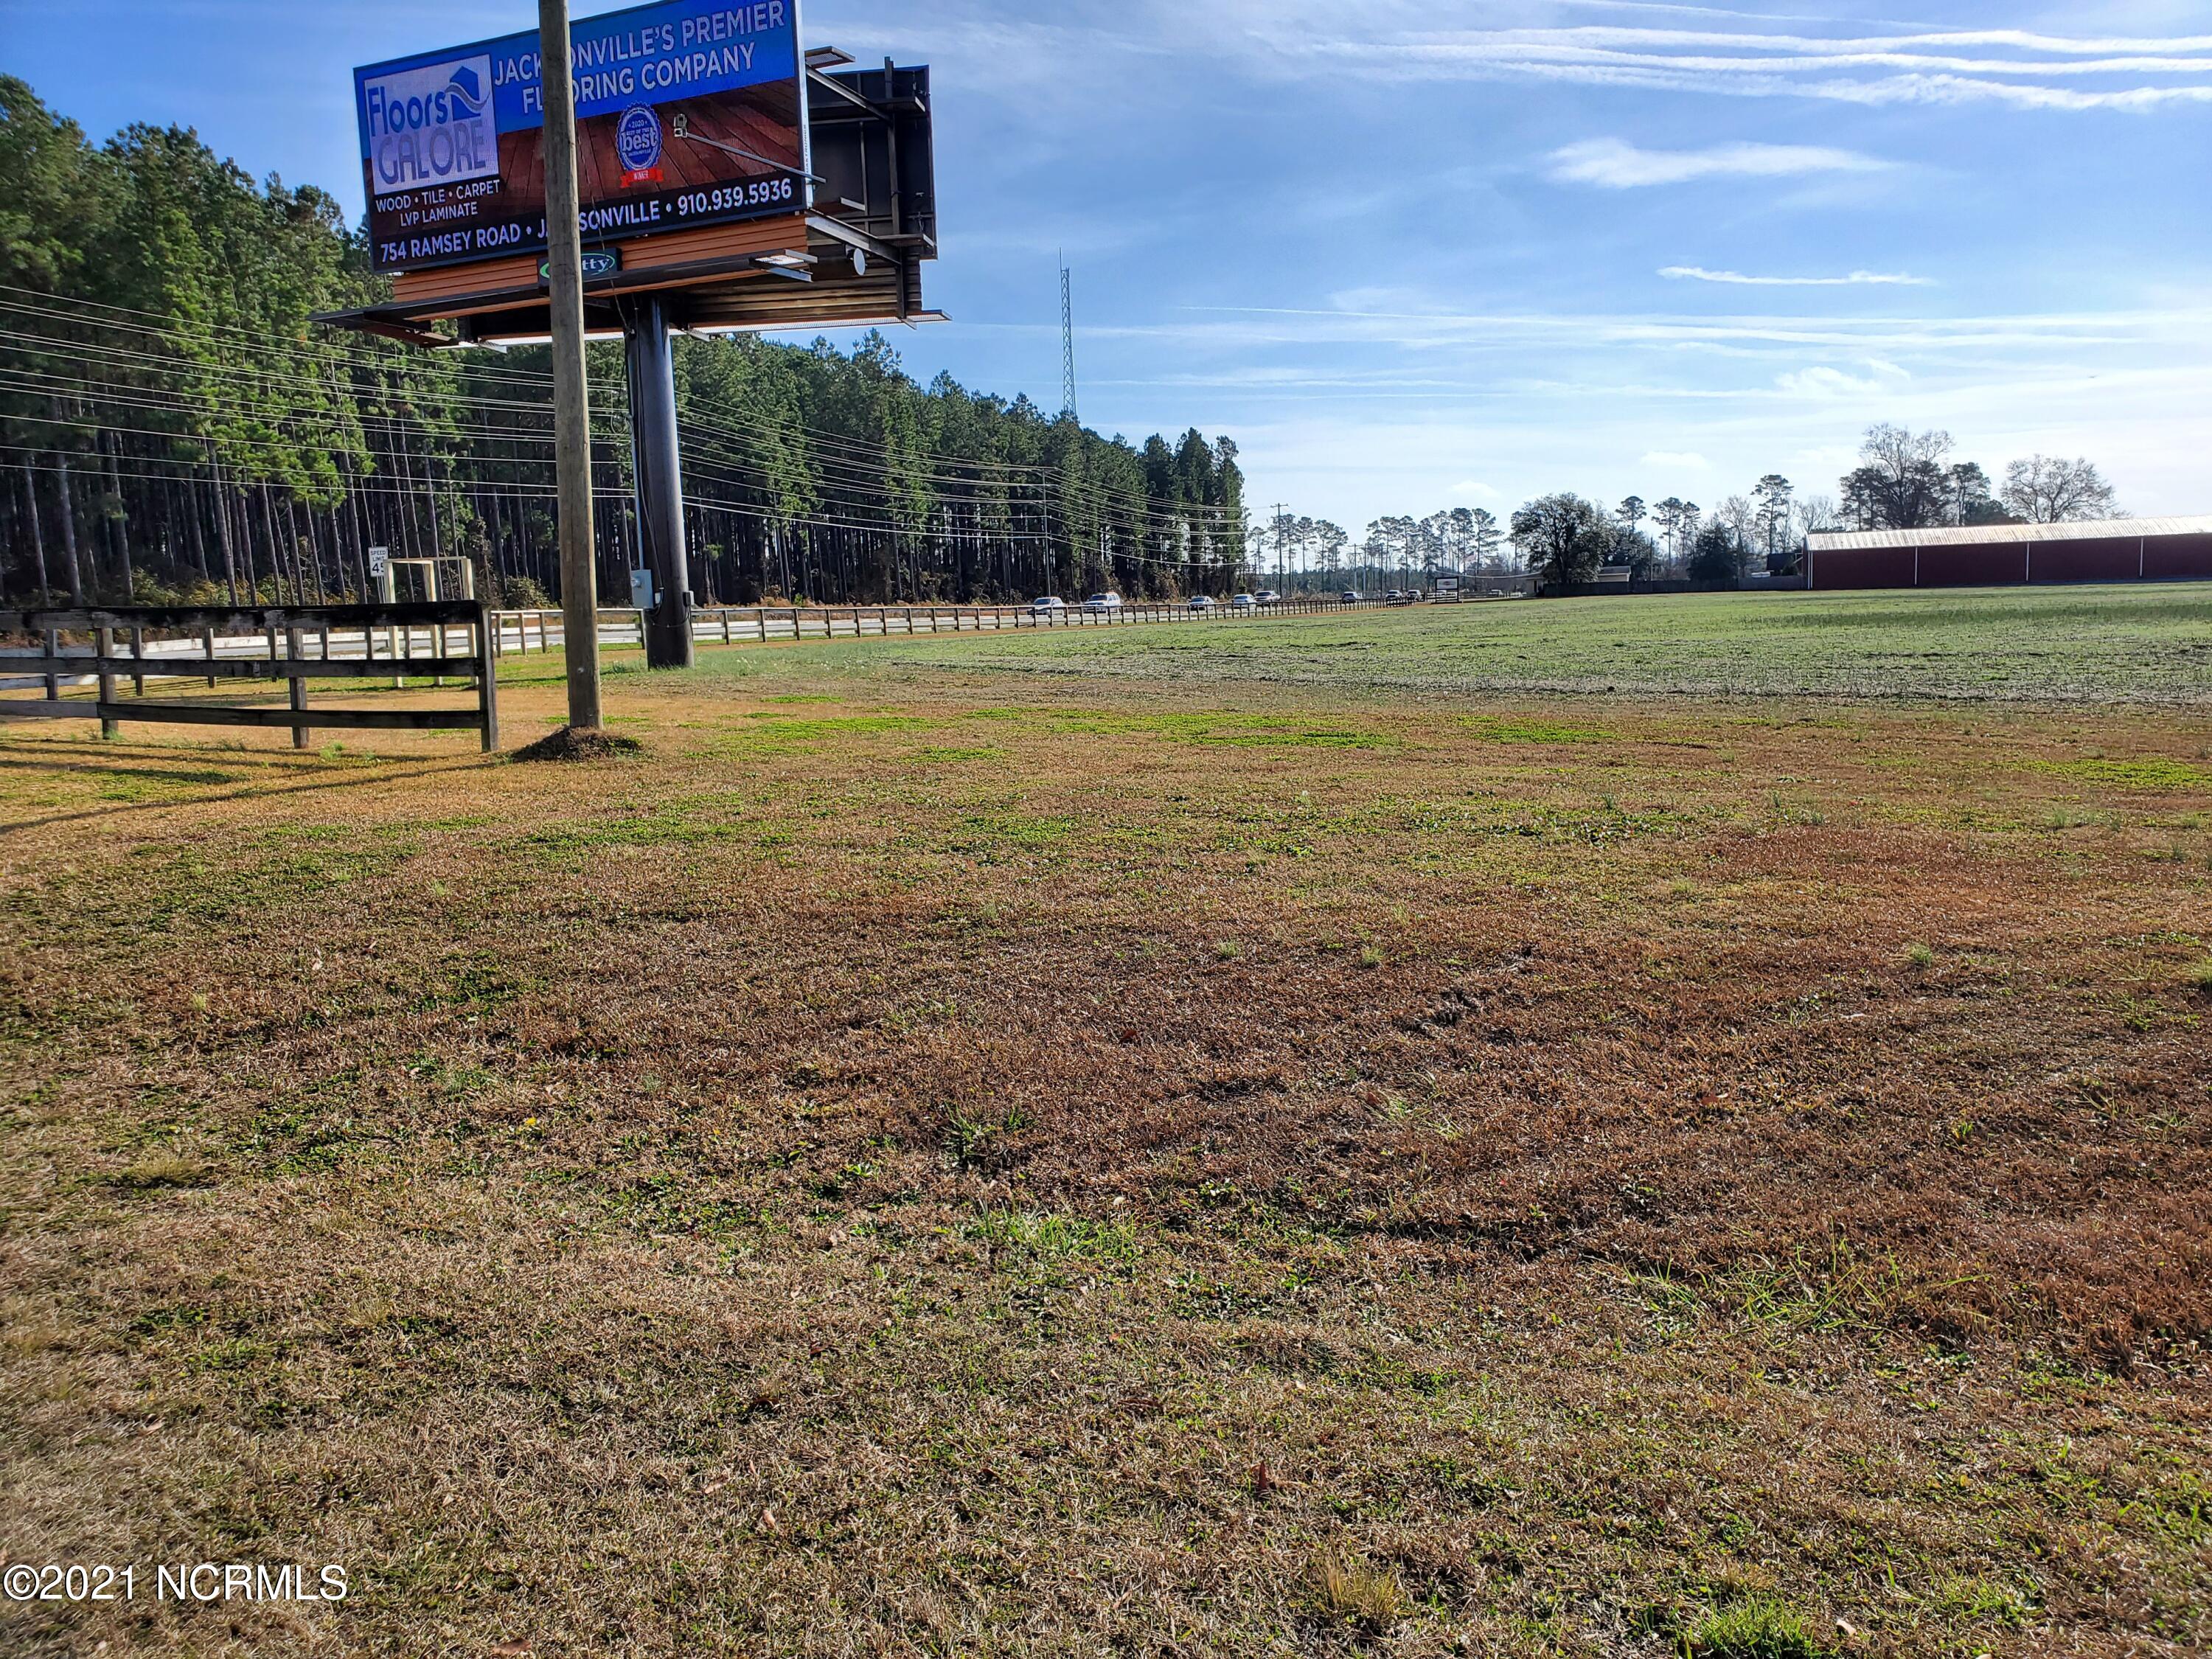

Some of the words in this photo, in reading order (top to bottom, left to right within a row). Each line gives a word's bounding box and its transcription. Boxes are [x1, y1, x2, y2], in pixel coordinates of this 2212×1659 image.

[495, 24, 674, 86] JACKNVILLE'S
[682, 1, 784, 47] PREMIER
[523, 68, 633, 114] FLRING
[641, 42, 756, 90] COMPANY
[367, 86, 448, 136] Floors
[621, 127, 657, 152] best
[378, 119, 486, 184] GALORE
[376, 195, 411, 213] WOOD
[422, 189, 446, 206] TILE
[456, 179, 500, 200] CARPET
[380, 242, 406, 263] 754
[411, 230, 472, 258] RAMSEY
[476, 223, 521, 248] ROAD
[538, 199, 660, 238] JSONVILLE
[678, 178, 792, 216] 910.939.5936
[400, 212, 420, 227] LVP
[422, 201, 478, 223] LAMINATE
